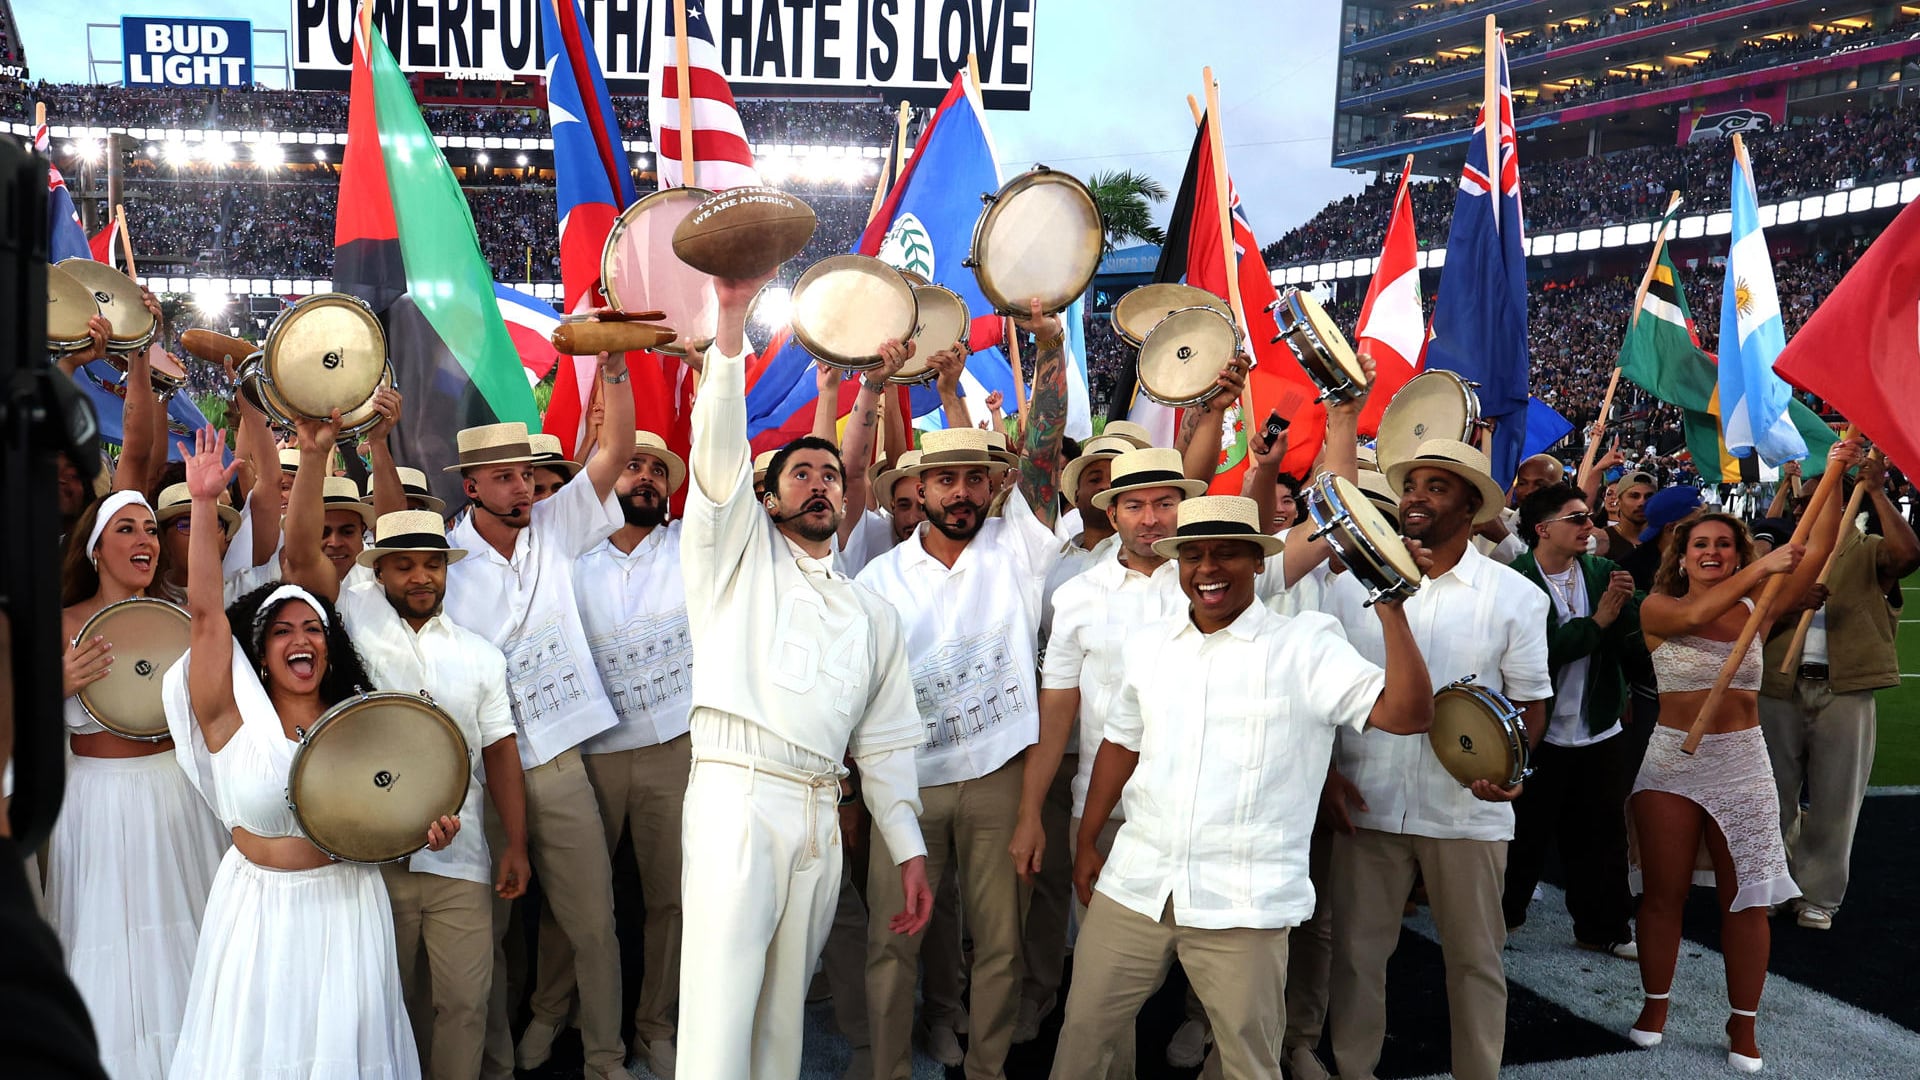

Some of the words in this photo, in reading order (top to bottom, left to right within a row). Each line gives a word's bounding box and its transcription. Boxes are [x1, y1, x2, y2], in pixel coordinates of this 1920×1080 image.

[145, 24, 229, 55] BUD
[721, 0, 841, 79] HATE
[856, 0, 898, 82] IS
[913, 0, 1029, 85] LOVE
[130, 54, 246, 86] LIGHT
[693, 209, 712, 225] WE
[713, 198, 738, 214] ARE
[740, 195, 794, 209] AMERICA
[696, 187, 787, 211] TOGETHER,
[376, 772, 390, 786] LP
